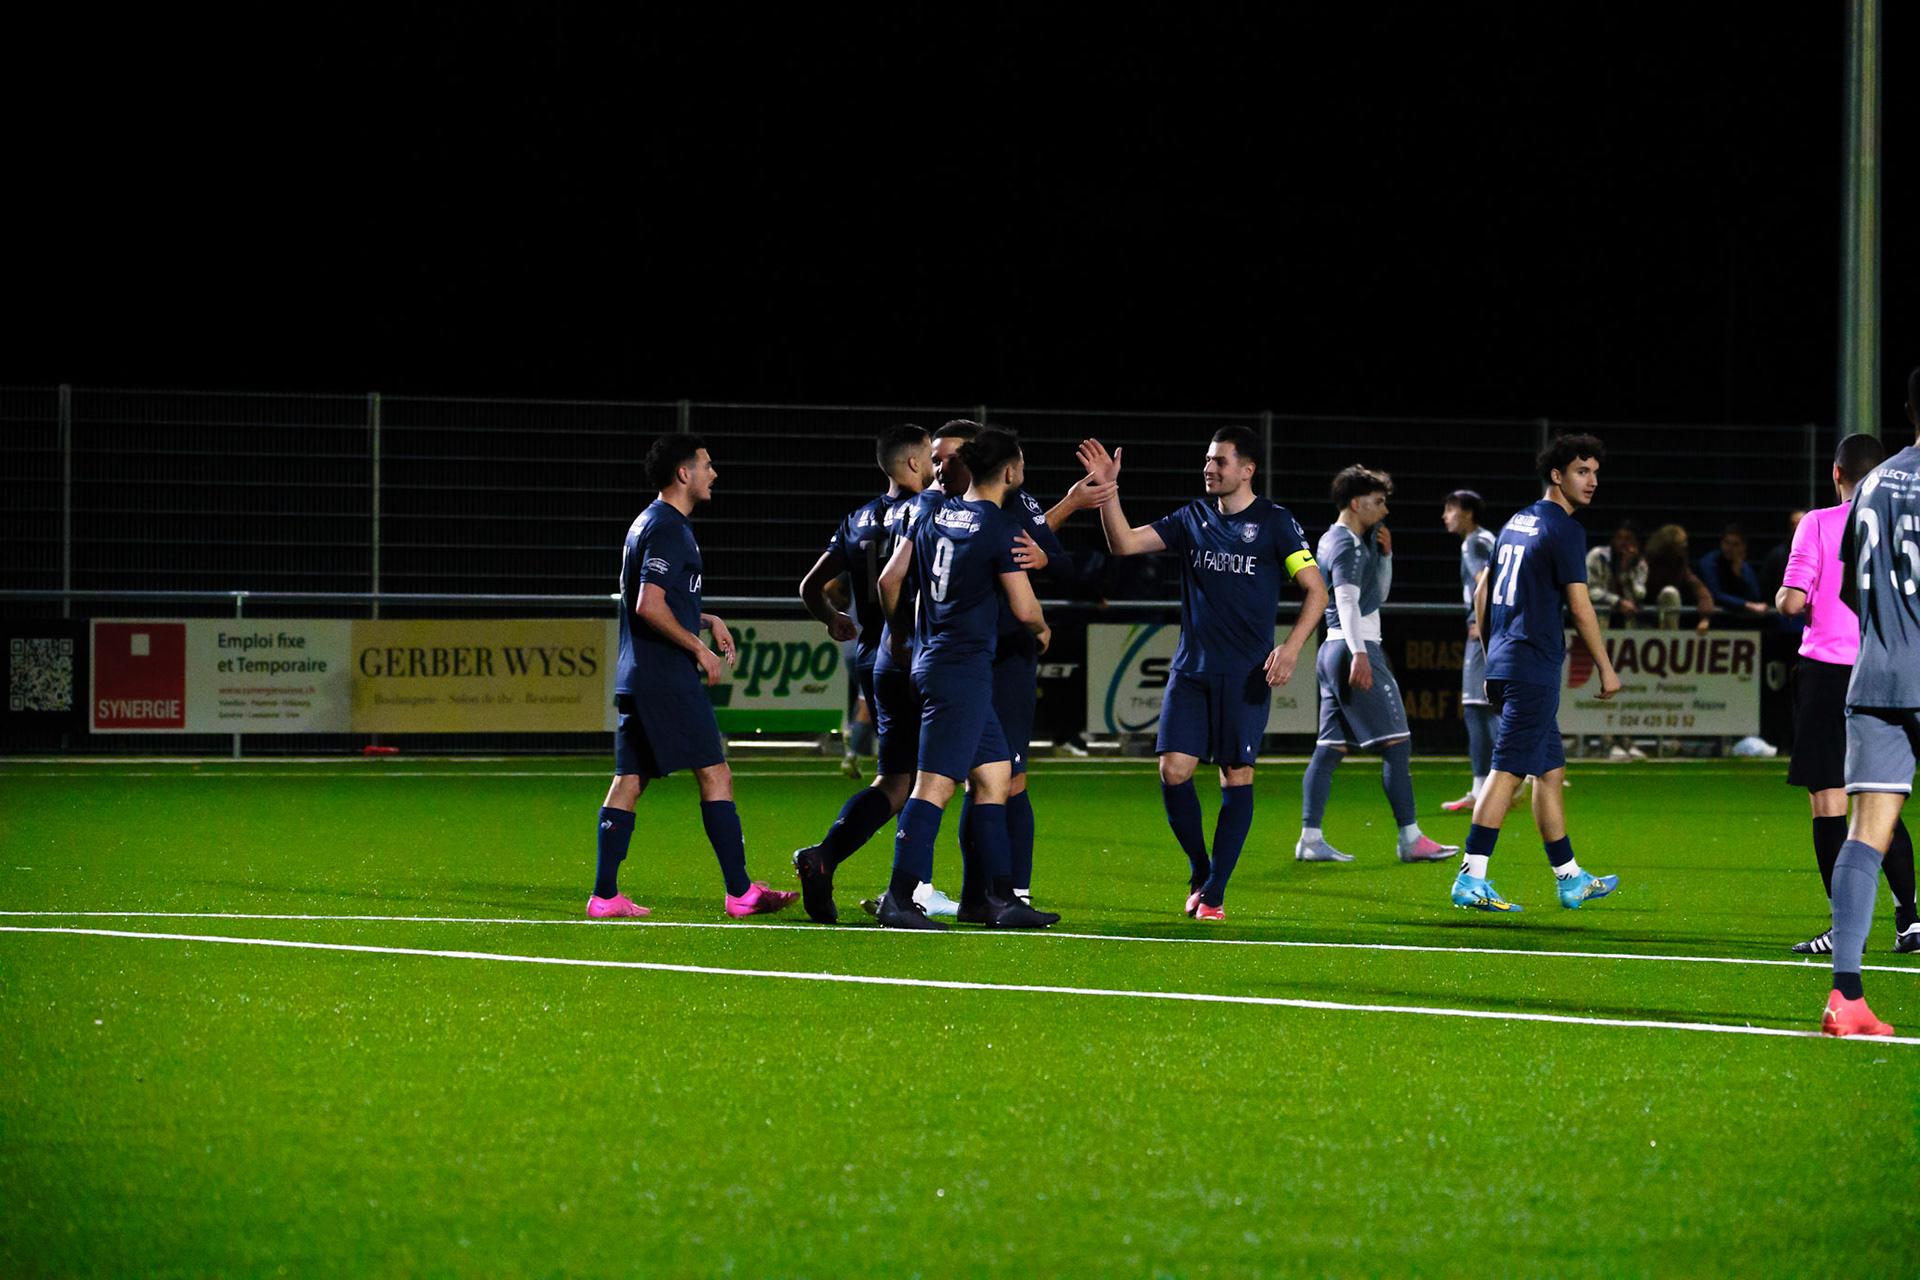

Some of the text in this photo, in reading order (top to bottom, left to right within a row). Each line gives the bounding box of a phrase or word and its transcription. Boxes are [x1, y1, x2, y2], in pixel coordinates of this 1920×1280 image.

[930, 537, 955, 603] 9
[1203, 550, 1257, 575] FABRIQUE
[1492, 543, 1525, 606] 21
[218, 632, 305, 652] Emploi fixe
[1406, 640, 1463, 669] BRAS
[217, 657, 327, 675] et Temporaire
[359, 647, 598, 678] GERBER WYSS
[98, 699, 181, 719] SYNERGIE
